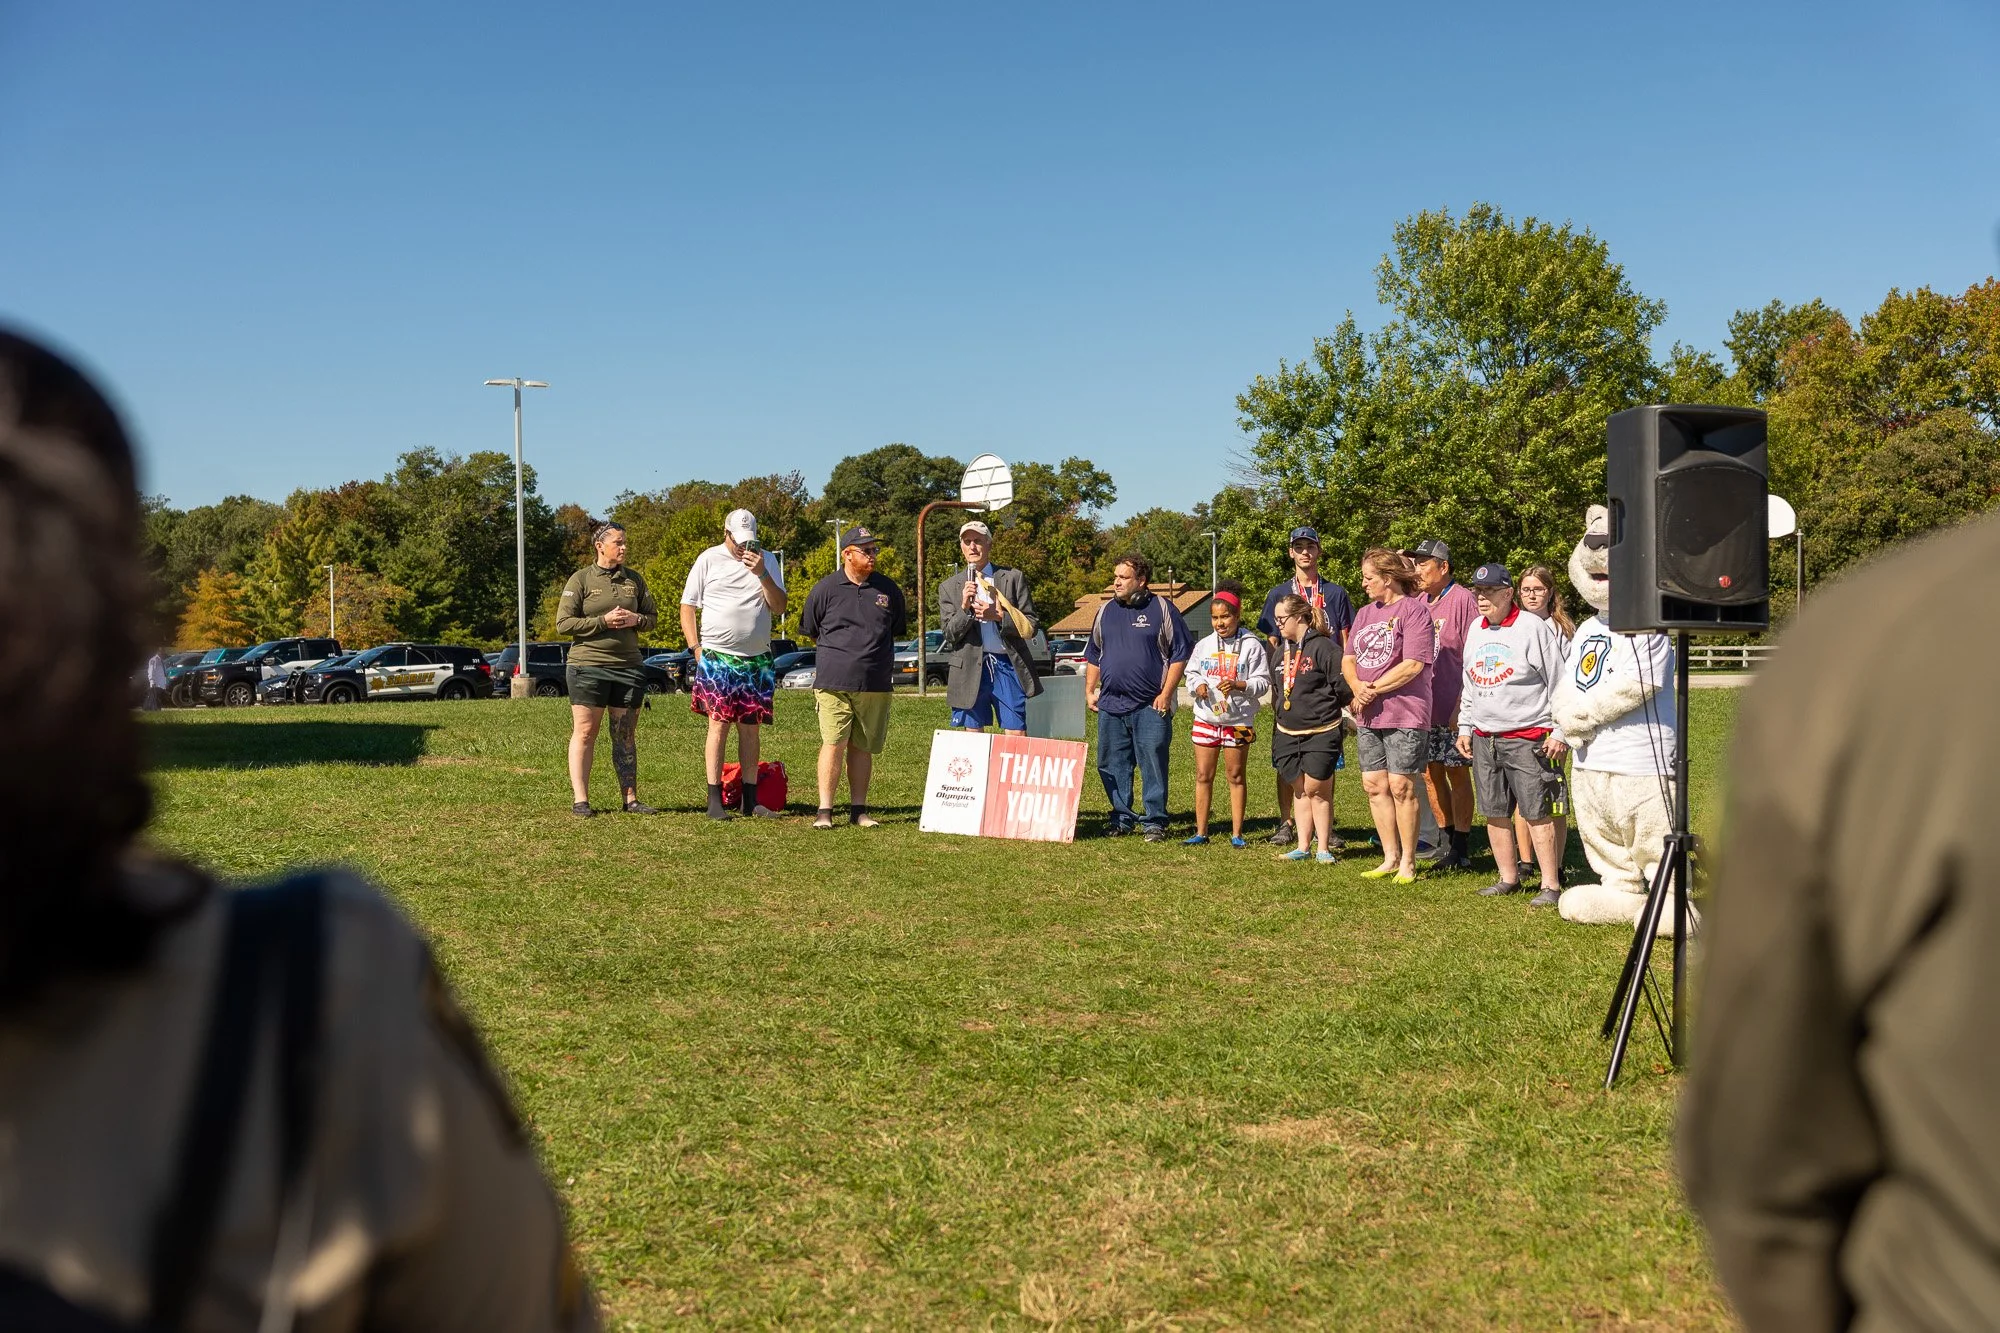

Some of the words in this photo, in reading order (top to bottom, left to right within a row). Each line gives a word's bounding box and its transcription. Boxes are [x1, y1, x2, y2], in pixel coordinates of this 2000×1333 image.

[385, 671, 436, 686] SHERIFF
[1469, 667, 1514, 686] MARYLAND
[999, 752, 1078, 789] THANK
[935, 791, 976, 801] Olympics
[940, 784, 974, 793] Special
[1007, 790, 1060, 823] YOU!
